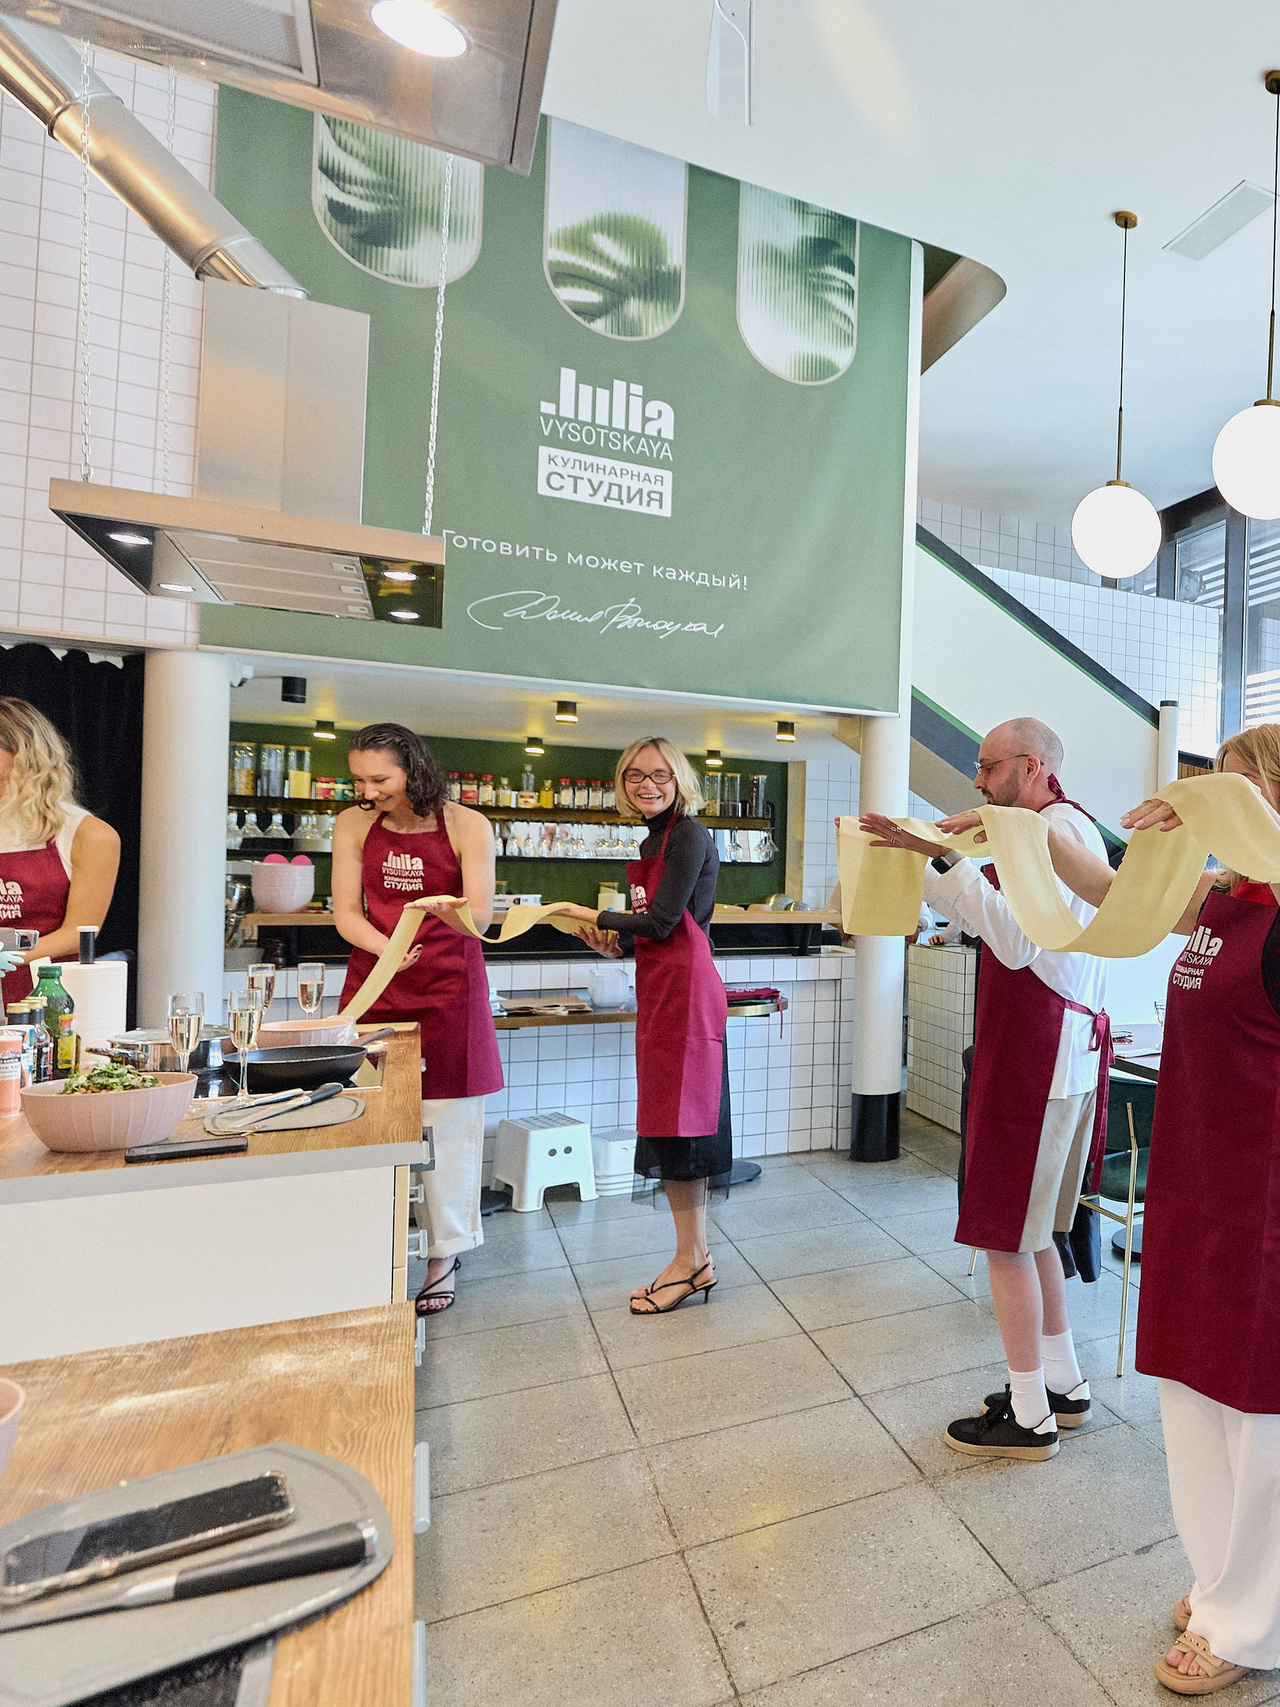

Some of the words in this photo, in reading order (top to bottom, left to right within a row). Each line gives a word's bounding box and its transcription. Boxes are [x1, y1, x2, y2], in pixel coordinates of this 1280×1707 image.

[540, 366, 675, 440] Julia
[540, 415, 673, 461] VYSOTSKAYA
[547, 453, 664, 486] КУЛИНАРНАЯ
[545, 471, 664, 510] СТУДИЯ
[567, 551, 644, 575] может
[652, 563, 748, 591] каждый!
[382, 850, 424, 870] Julia
[383, 880, 424, 892] СТУДИЯ
[1172, 972, 1203, 990] СТУДИЯ
